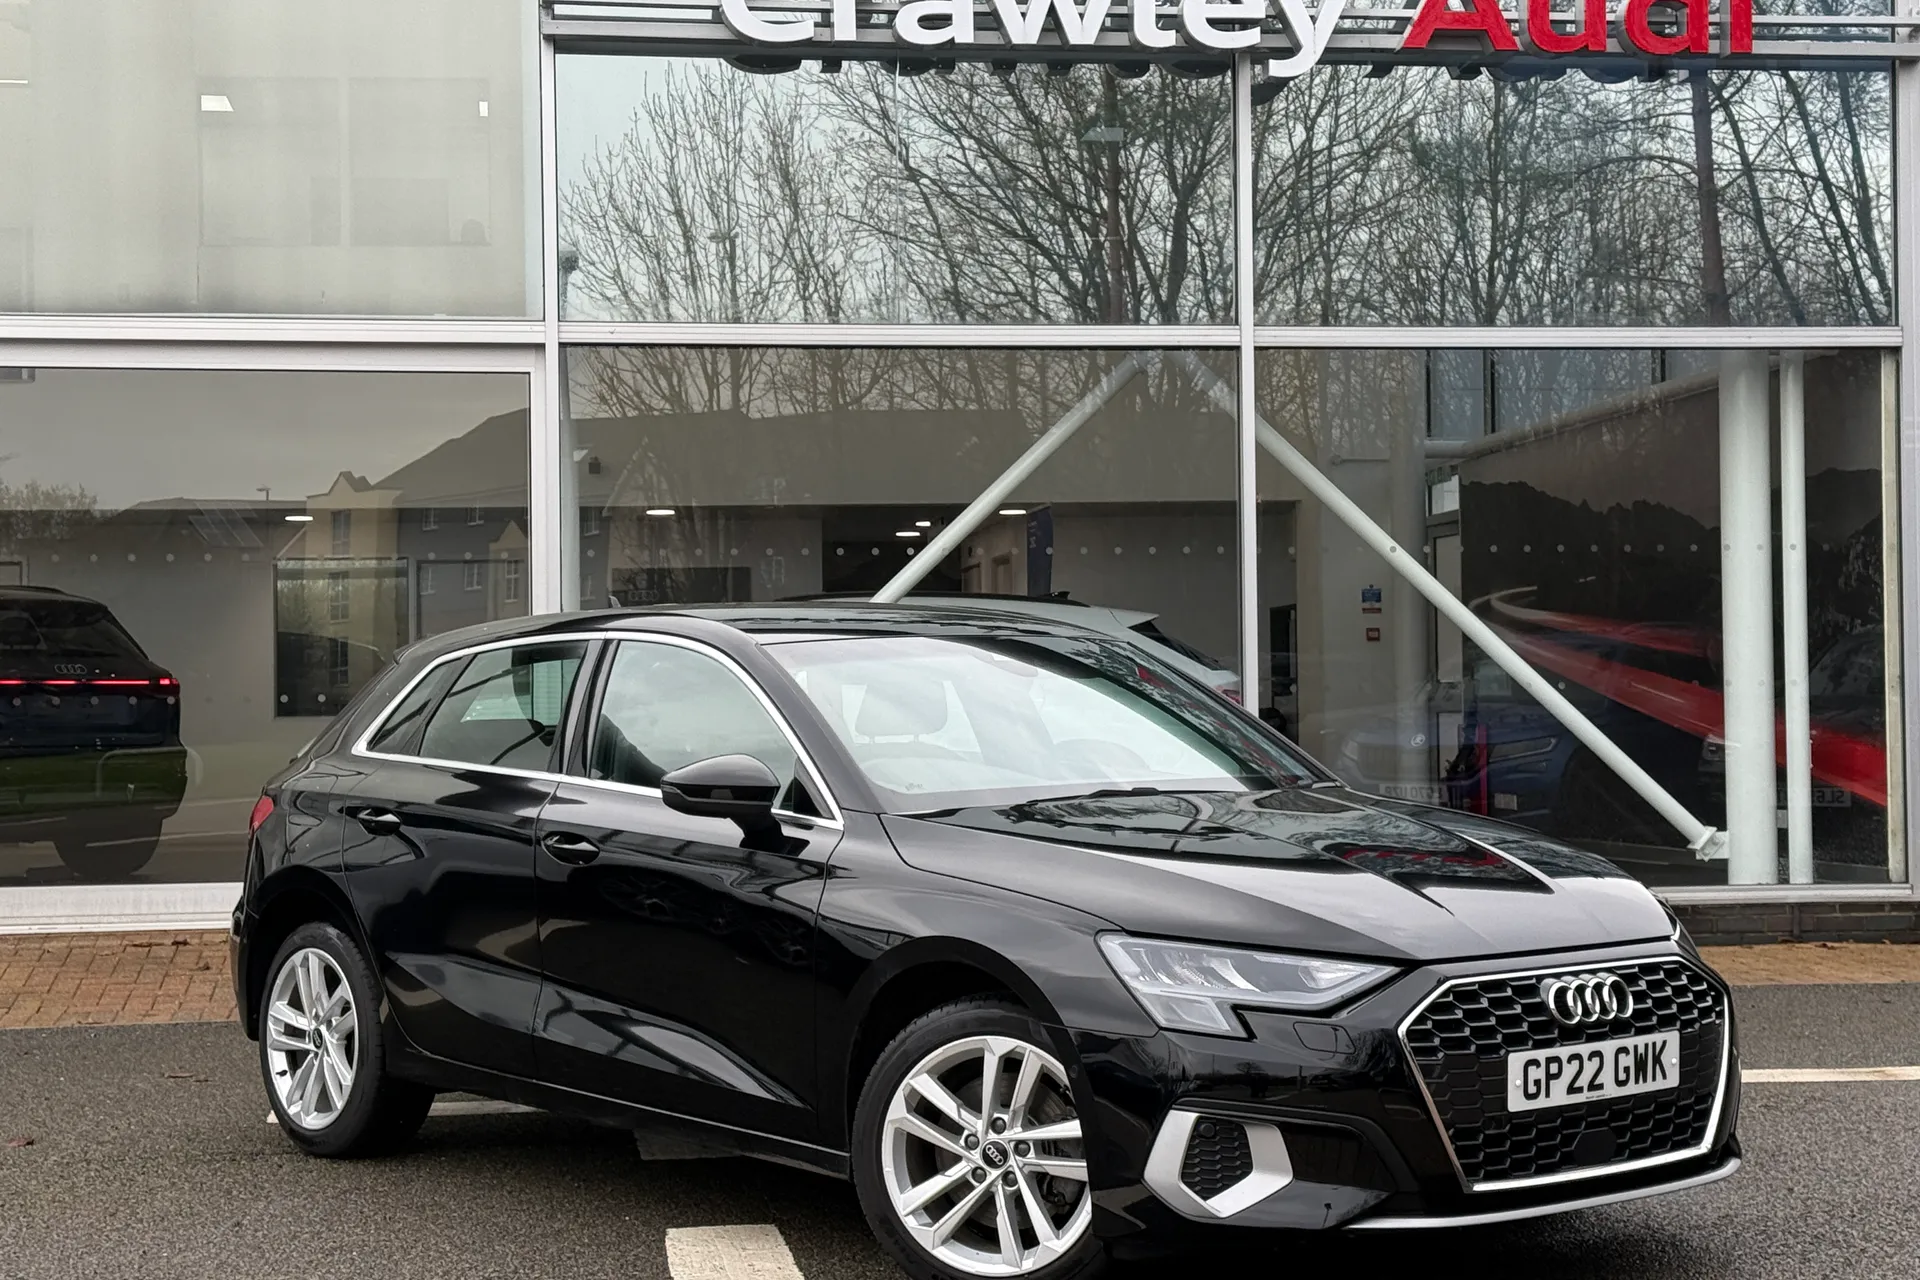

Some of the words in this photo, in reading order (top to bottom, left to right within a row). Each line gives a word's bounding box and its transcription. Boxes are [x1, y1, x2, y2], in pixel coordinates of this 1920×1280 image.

[1403, 0, 1752, 55] Audi
[1522, 1050, 1604, 1101] GP22
[1614, 1040, 1667, 1087] GWK
